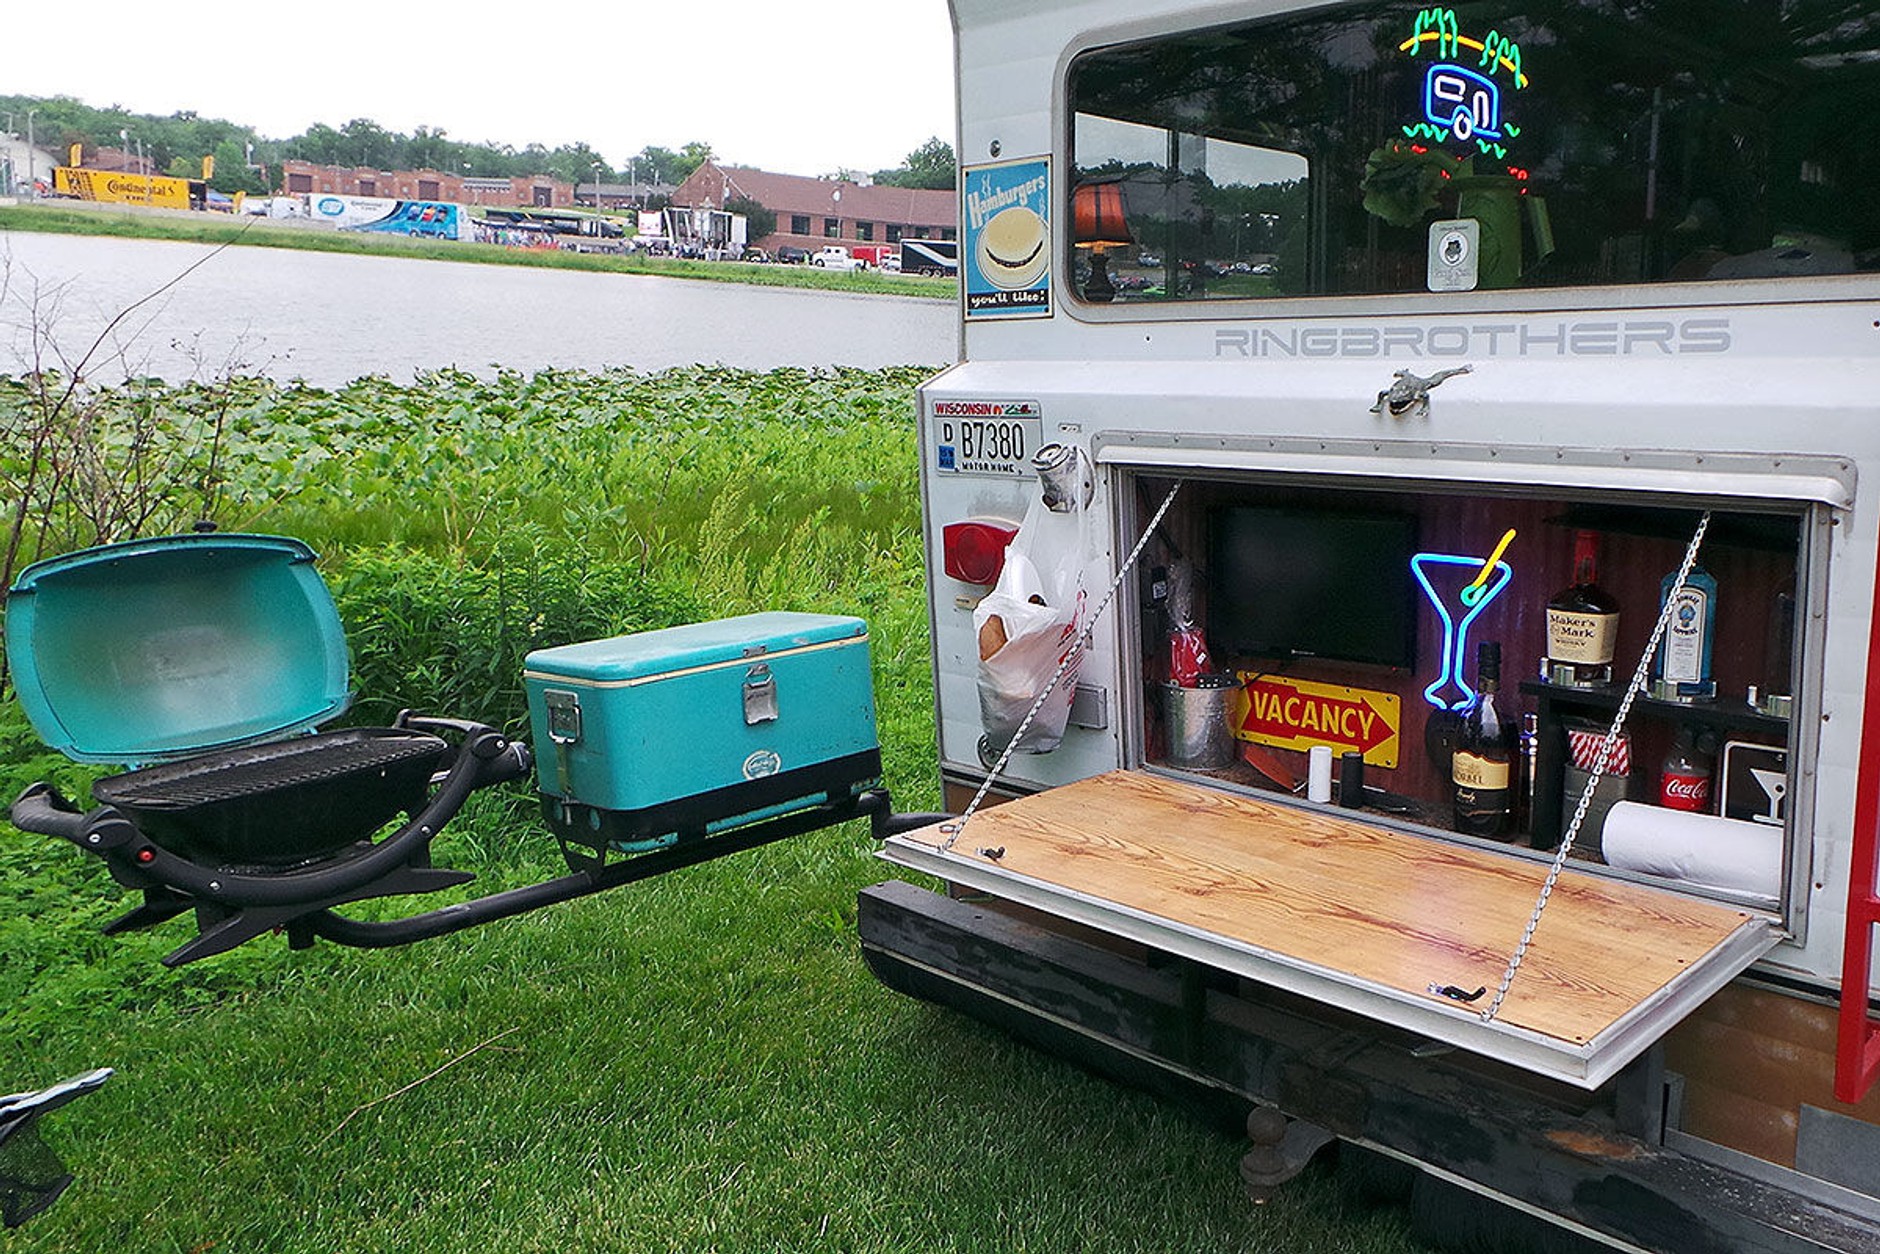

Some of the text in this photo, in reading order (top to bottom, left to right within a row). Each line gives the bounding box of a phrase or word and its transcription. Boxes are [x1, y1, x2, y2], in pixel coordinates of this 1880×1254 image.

[967, 175, 1046, 230] Hamburgers
[1215, 319, 1731, 357] RINGBROTHERS
[935, 402, 991, 415] WISCONSIN
[943, 423, 953, 442] D
[961, 421, 1024, 461] B7380
[1550, 614, 1596, 628] Maker's
[1560, 626, 1595, 638] Mark
[1253, 690, 1376, 741] VACANCY
